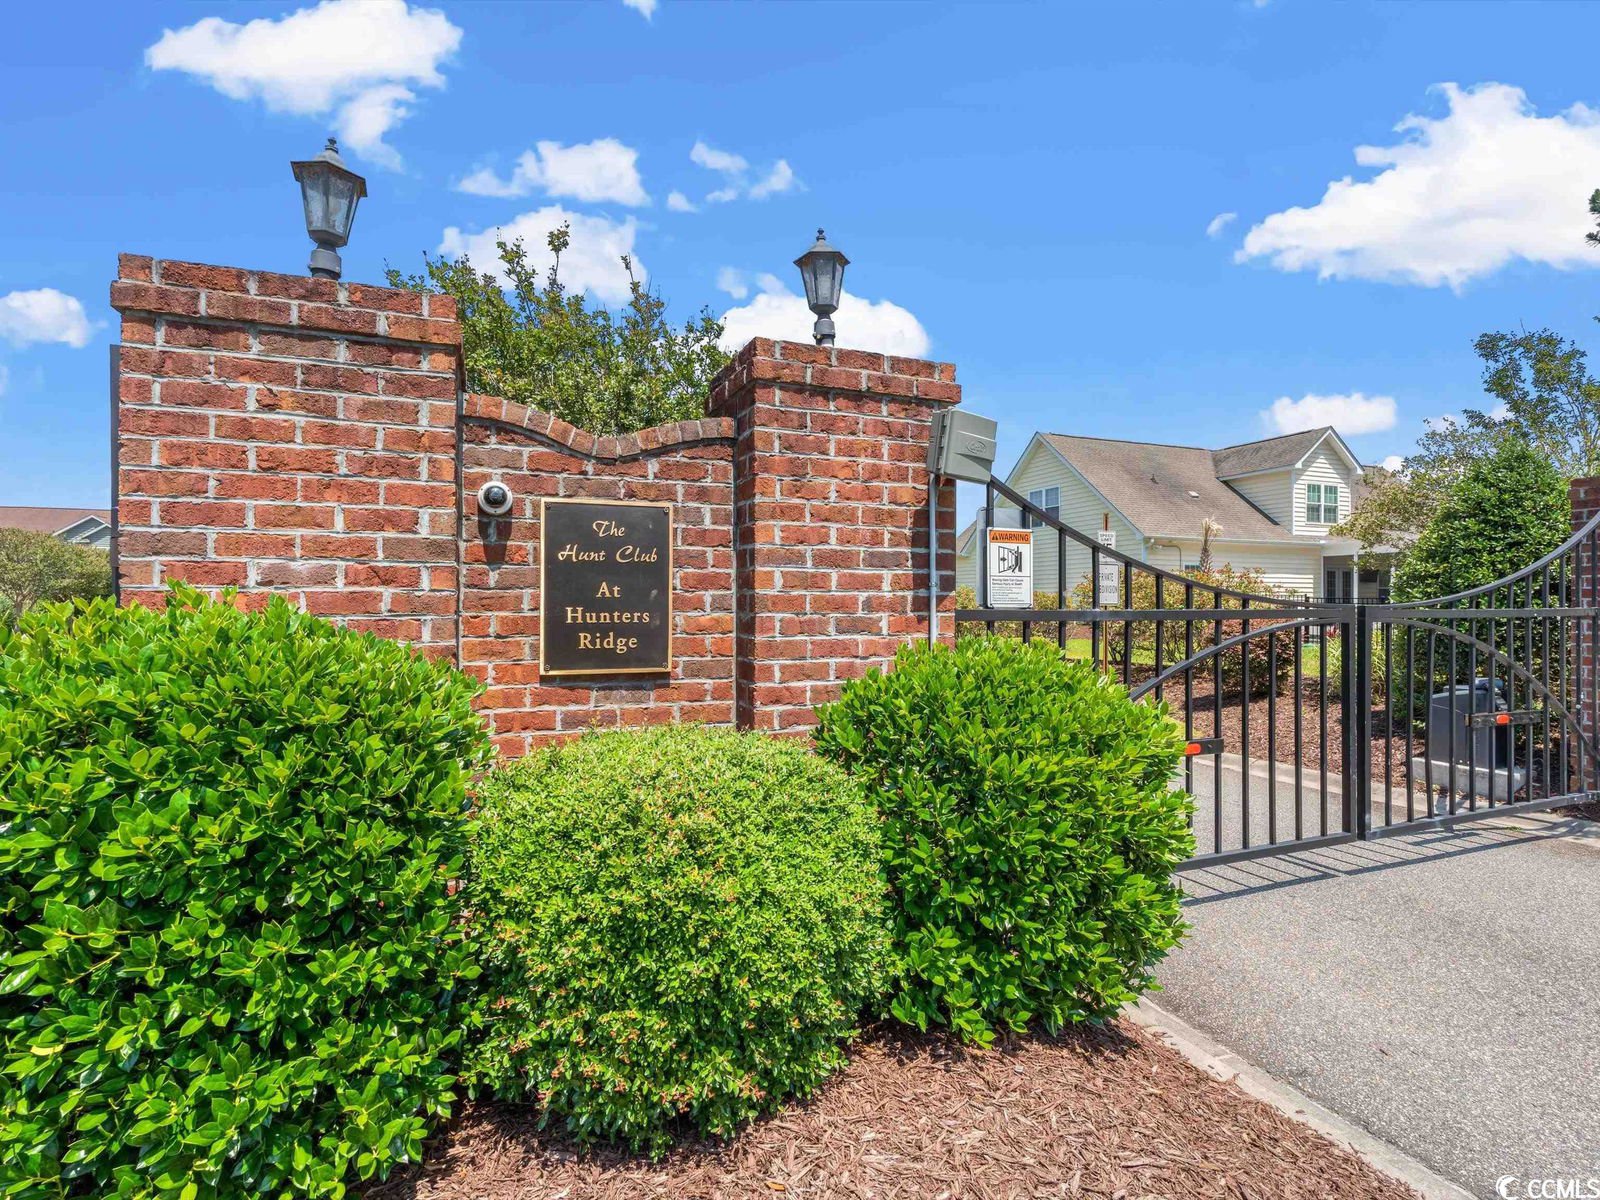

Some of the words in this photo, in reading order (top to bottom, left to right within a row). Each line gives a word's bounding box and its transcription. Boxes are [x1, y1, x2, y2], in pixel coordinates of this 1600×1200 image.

[592, 520, 625, 537] The
[999, 532, 1029, 542] WARNING
[558, 544, 606, 563] Hunt
[615, 545, 658, 563] Club
[596, 581, 621, 598] At
[565, 607, 650, 624] Hunters
[578, 632, 638, 653] Ridge
